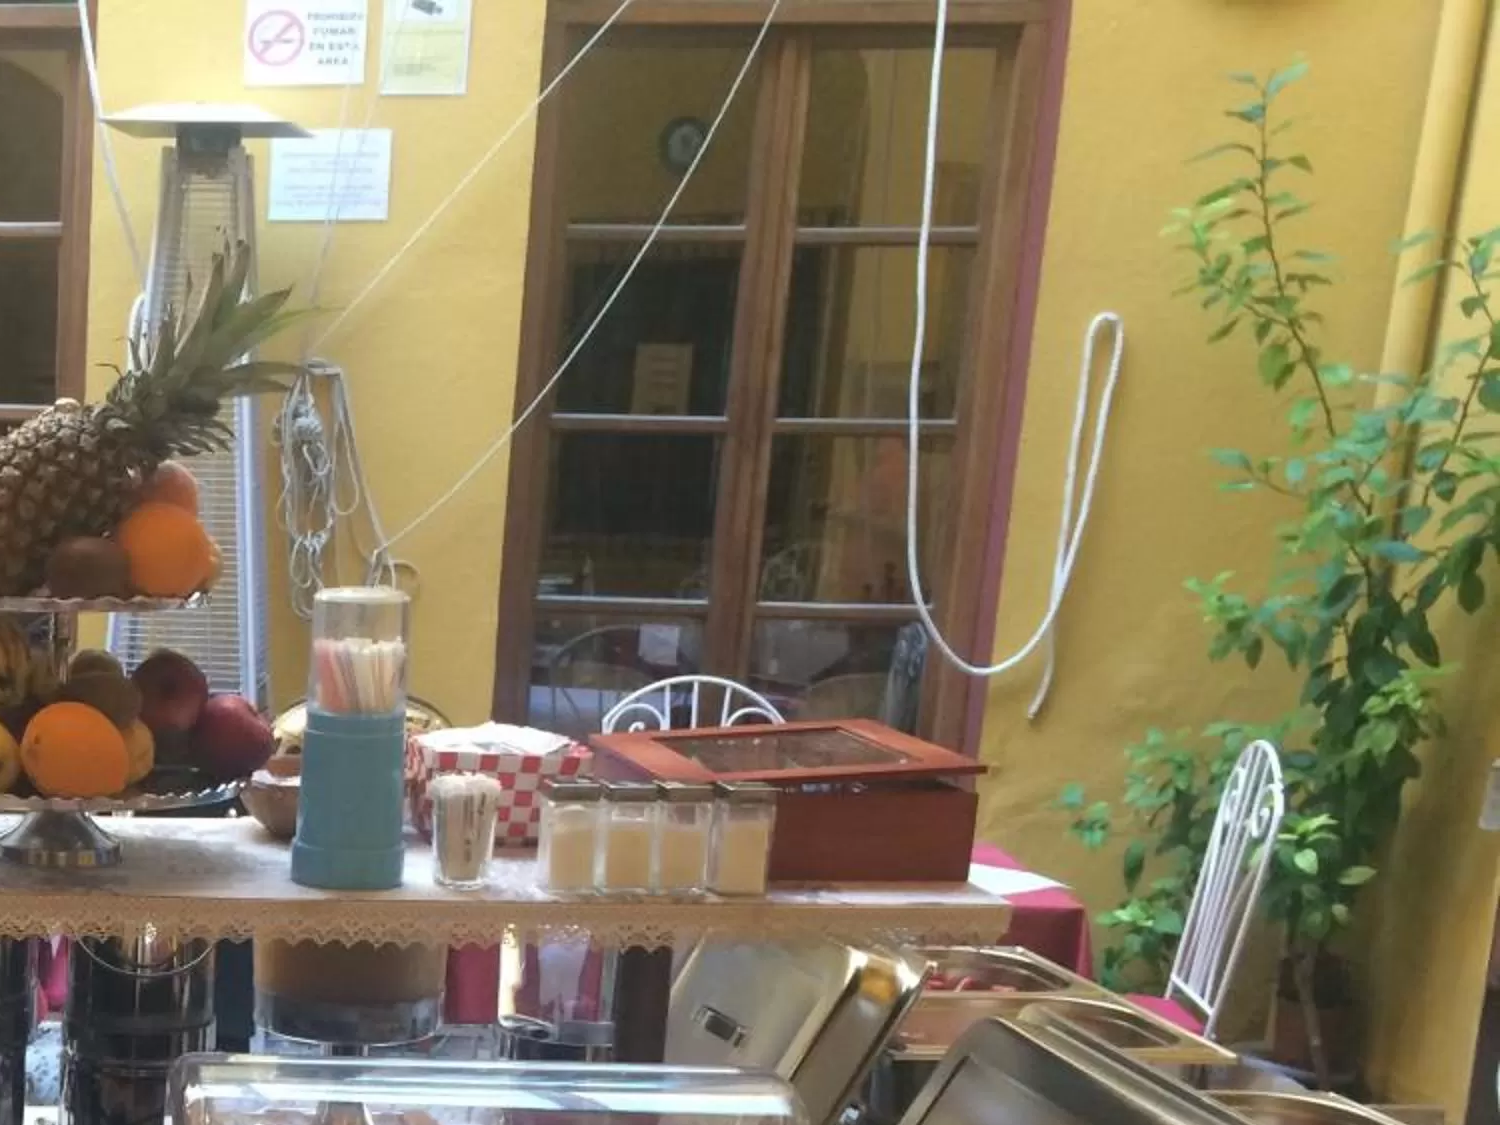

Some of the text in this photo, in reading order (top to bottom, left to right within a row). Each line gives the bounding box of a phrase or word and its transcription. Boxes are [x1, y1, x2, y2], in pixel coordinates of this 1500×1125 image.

[312, 27, 356, 37] FUMAR
[309, 41, 360, 51] EN ESTA
